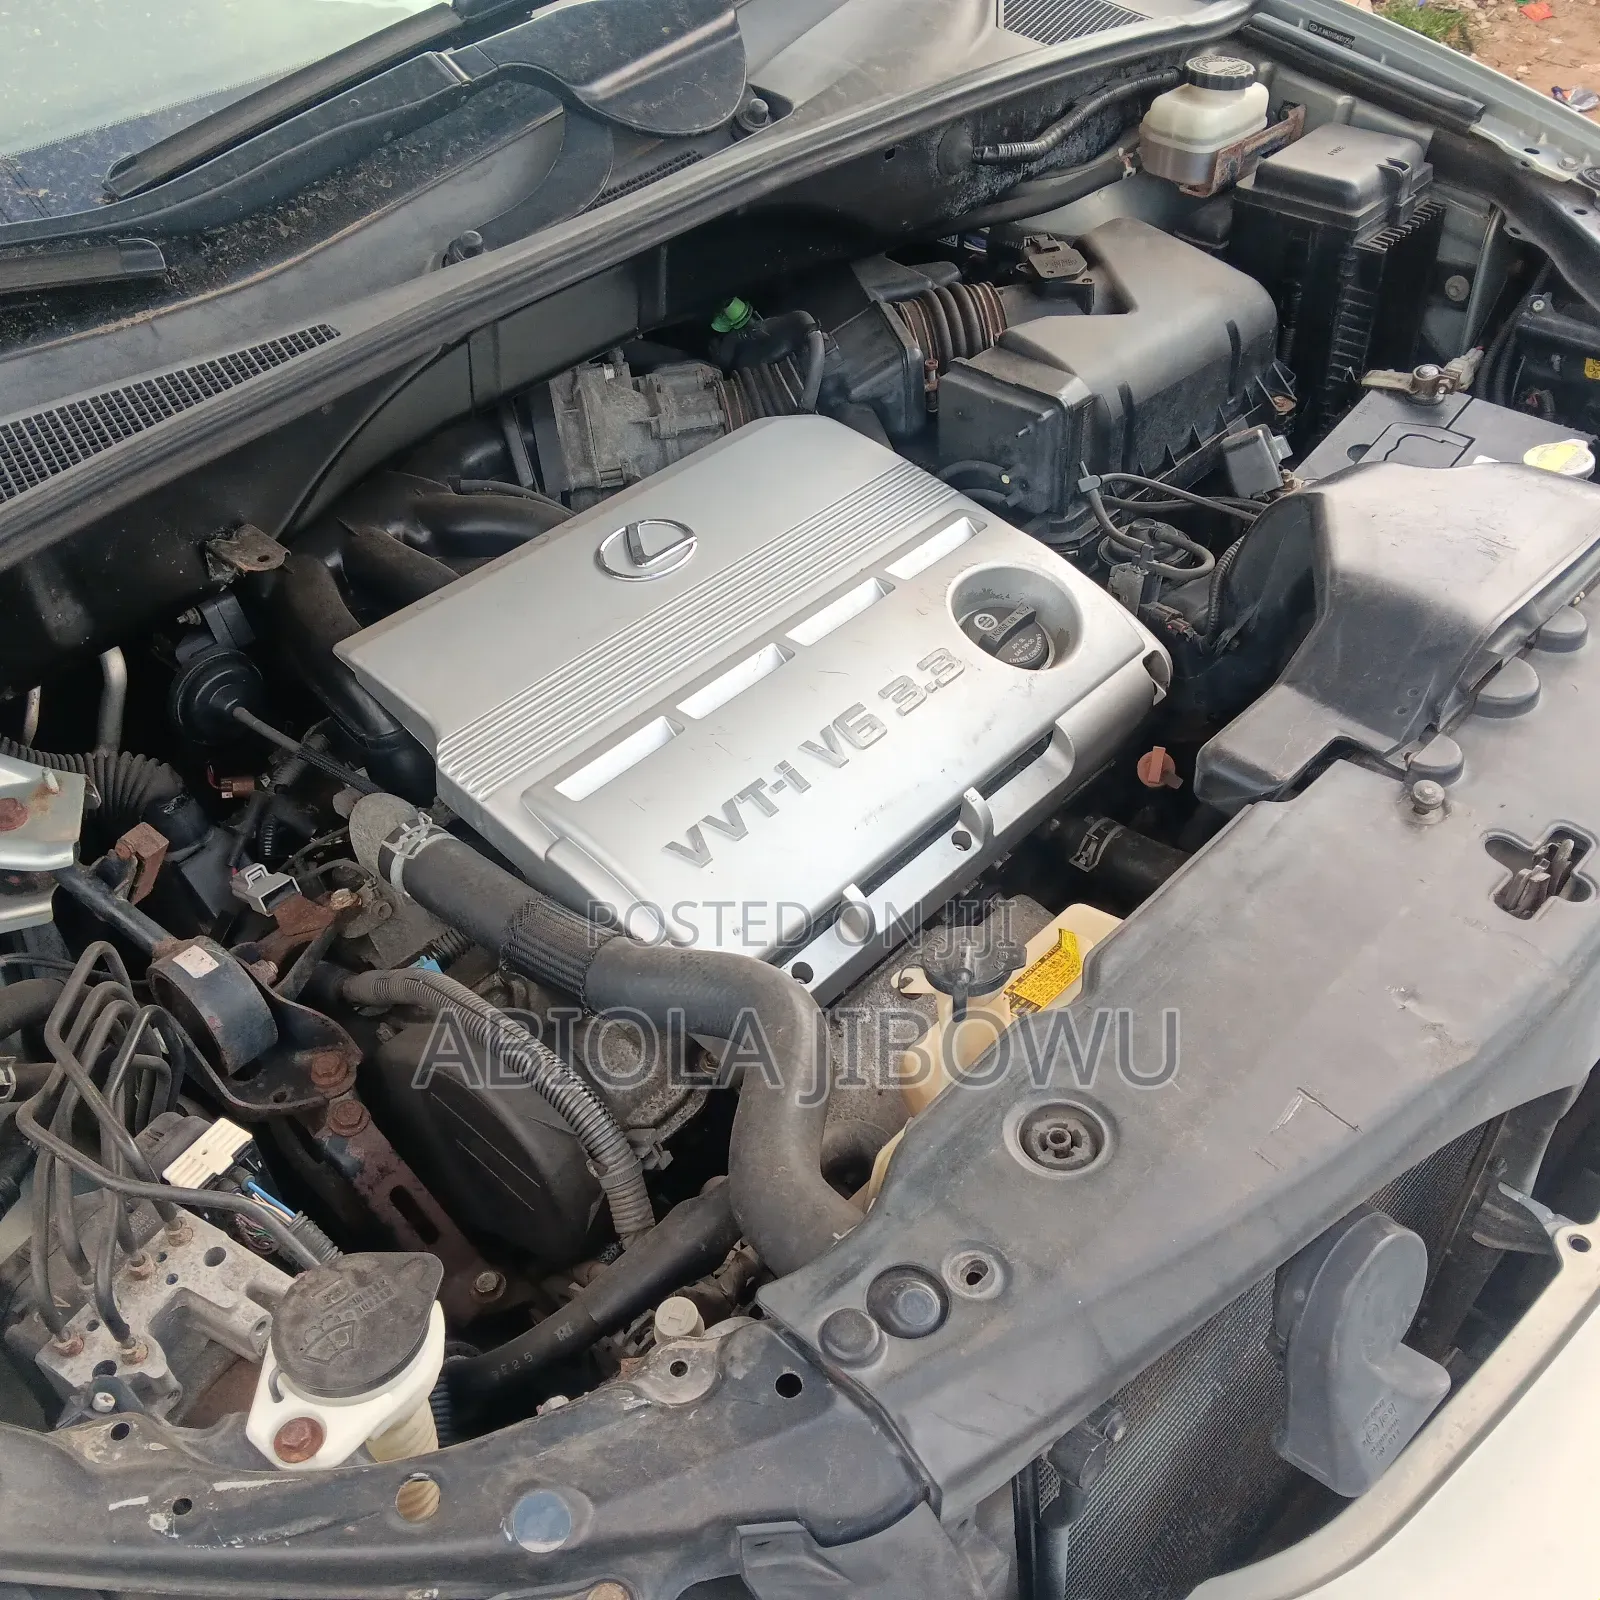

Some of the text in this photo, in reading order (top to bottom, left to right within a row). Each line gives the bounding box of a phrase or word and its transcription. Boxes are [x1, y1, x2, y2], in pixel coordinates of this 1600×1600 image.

[661, 646, 966, 869] VVT-i V6 3.3
